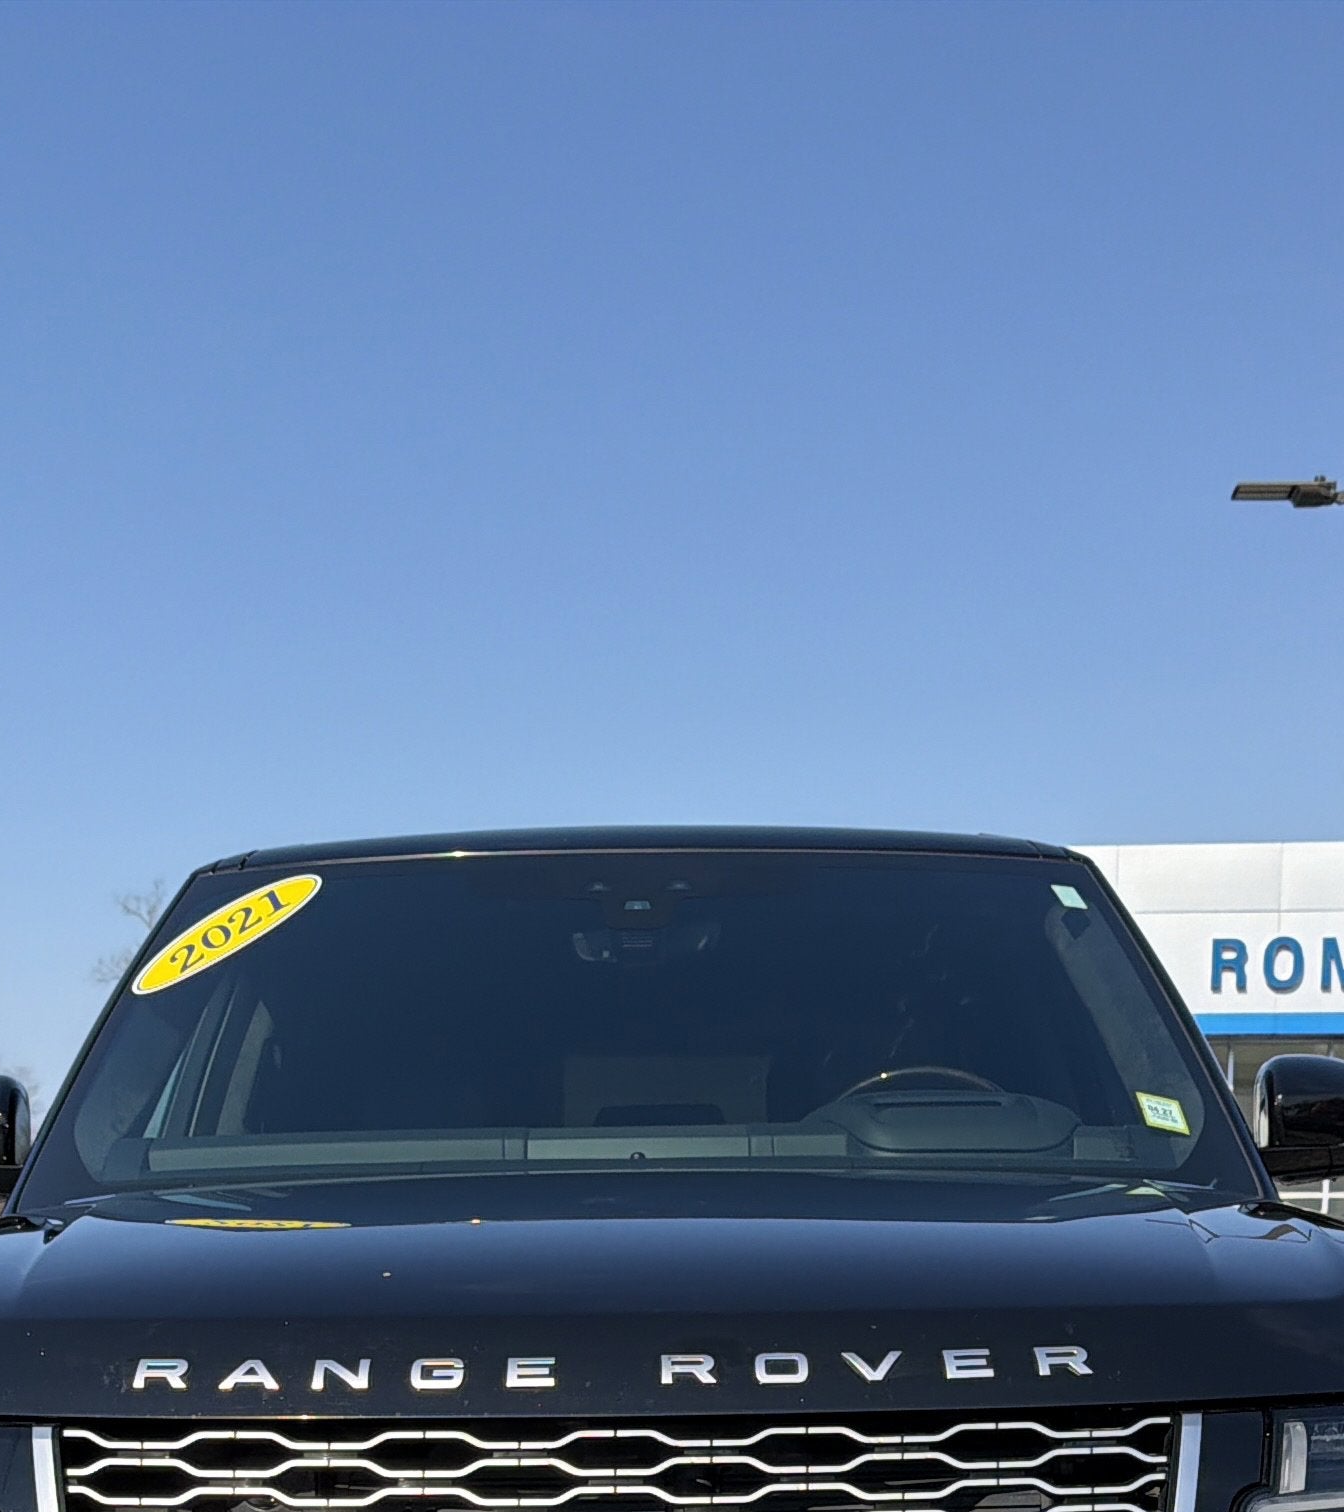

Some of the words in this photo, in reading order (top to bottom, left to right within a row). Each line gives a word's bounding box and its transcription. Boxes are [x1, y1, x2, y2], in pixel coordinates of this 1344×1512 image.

[169, 889, 291, 975] 2021
[131, 1356, 557, 1392] RANGE
[659, 1345, 1095, 1385] ROVER
